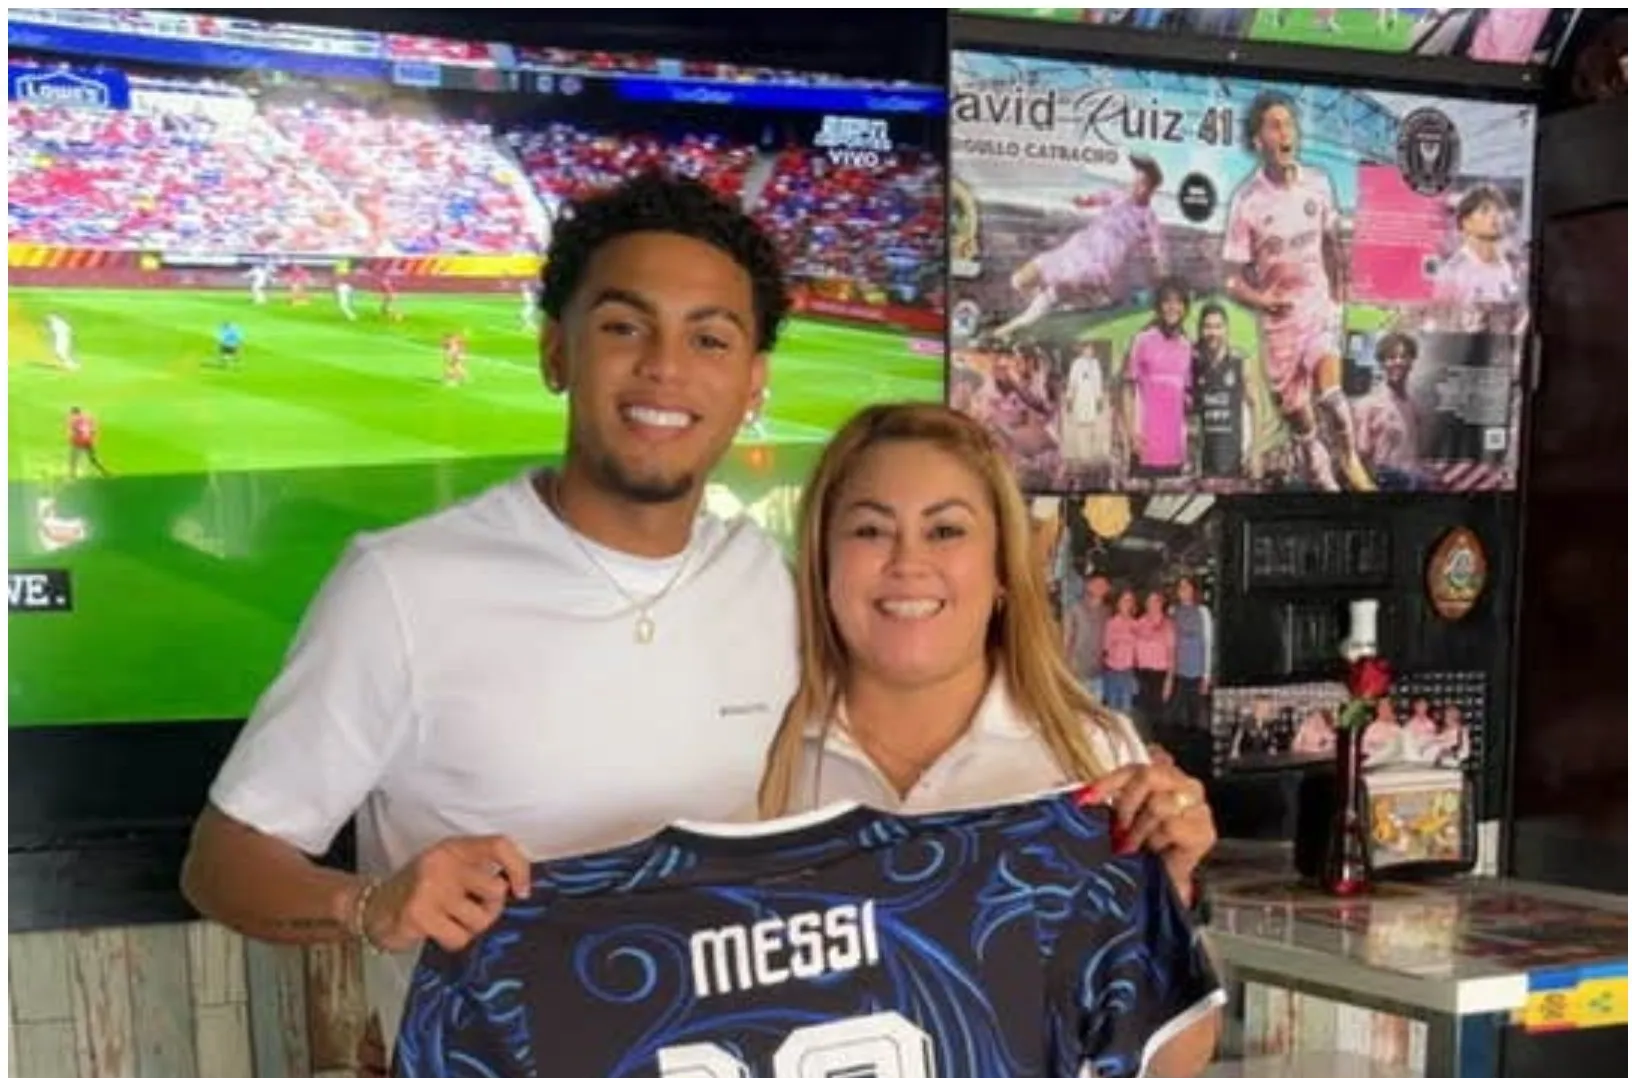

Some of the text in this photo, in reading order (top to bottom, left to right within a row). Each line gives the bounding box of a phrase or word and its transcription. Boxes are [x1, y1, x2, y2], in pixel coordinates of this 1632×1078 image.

[954, 87, 1234, 146] avid Ruiz 41
[691, 899, 879, 998] MESSI
